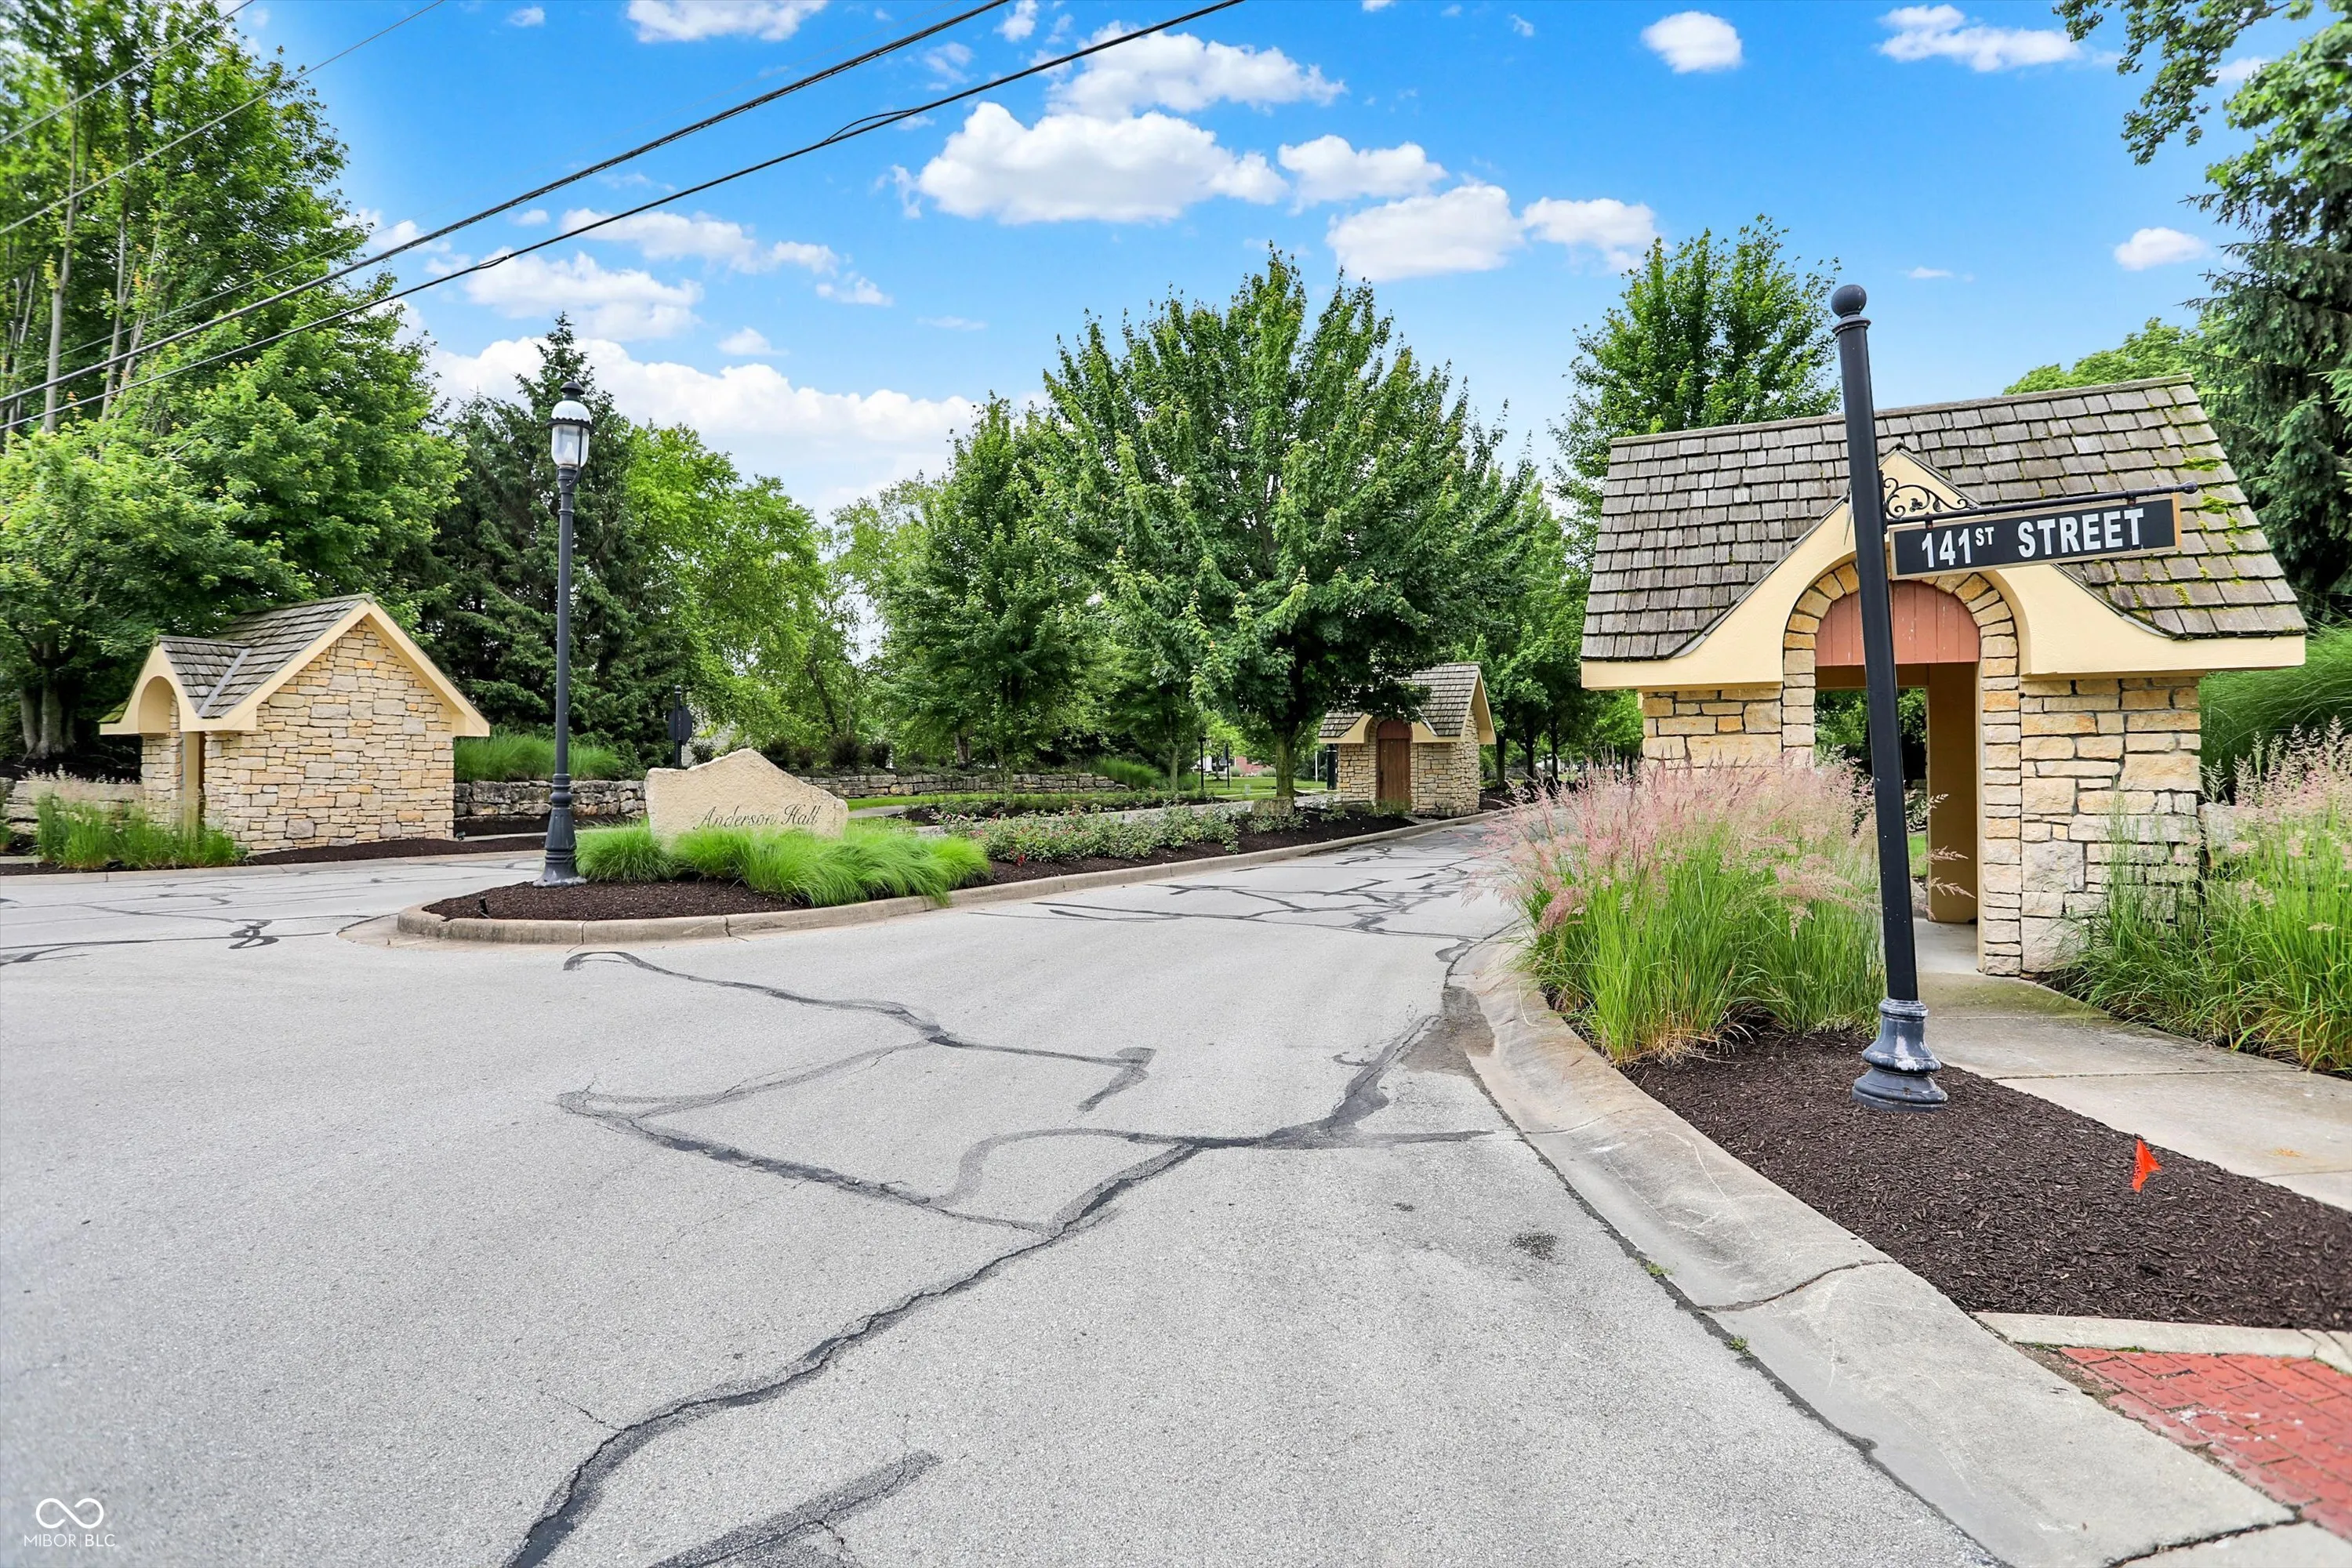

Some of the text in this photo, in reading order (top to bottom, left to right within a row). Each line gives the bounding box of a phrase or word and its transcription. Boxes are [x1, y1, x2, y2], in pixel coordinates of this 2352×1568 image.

[1922, 508, 2144, 568] 141ST STREET
[692, 804, 822, 830] Anderson Hall
